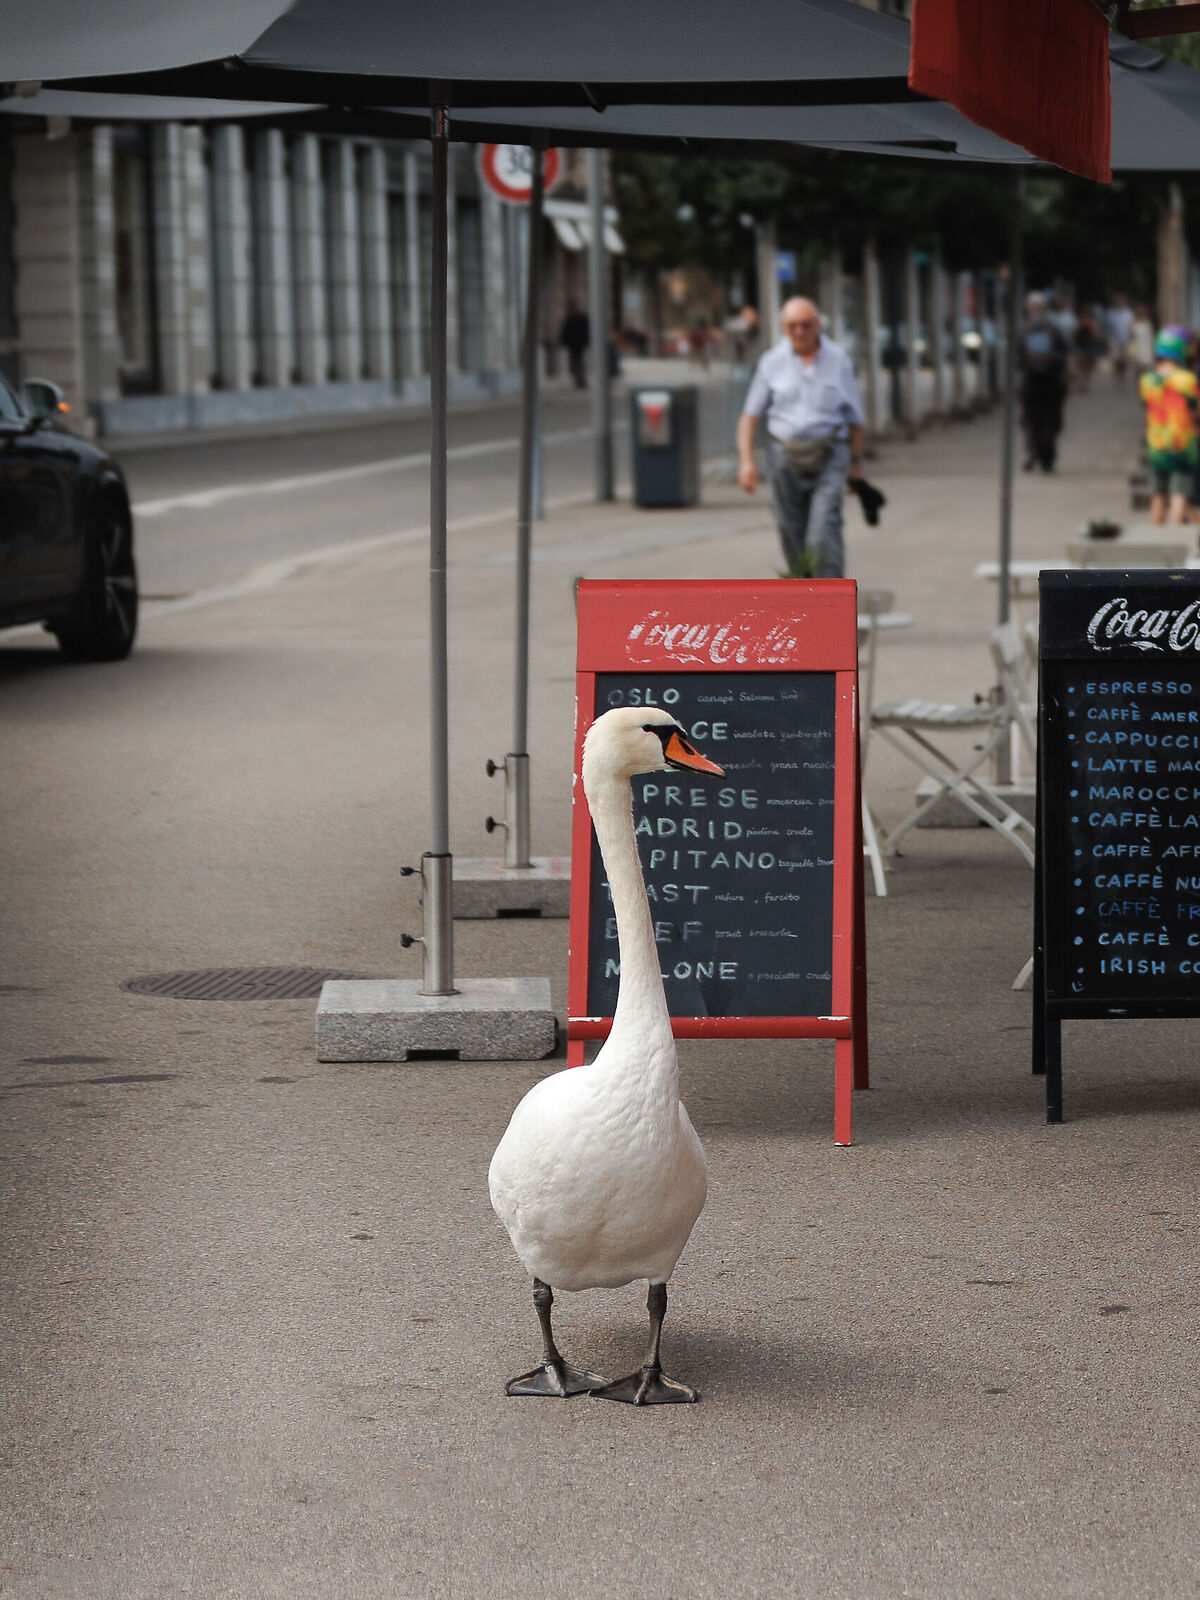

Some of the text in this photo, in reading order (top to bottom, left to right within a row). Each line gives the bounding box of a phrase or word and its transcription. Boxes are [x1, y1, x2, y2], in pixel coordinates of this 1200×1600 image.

[607, 688, 680, 705] OSLO
[1086, 681, 1193, 695] ESPRESSO
[1087, 702, 1141, 721] CAFFÈ
[690, 721, 728, 740] CE
[1087, 758, 1158, 773] LATTE
[642, 784, 759, 809] PRESE
[1088, 807, 1162, 828] CAFFÈ
[635, 816, 743, 840] ADRID
[1092, 837, 1153, 858] CAFFÈ
[649, 849, 775, 869] PITANO
[1094, 866, 1164, 889] CAFFÈ
[600, 882, 710, 904] TAST
[1098, 897, 1160, 919] CAFFÈ
[605, 918, 703, 943] BEF
[1098, 926, 1171, 946] CAFFÈ
[1100, 957, 1166, 975] IRISH
